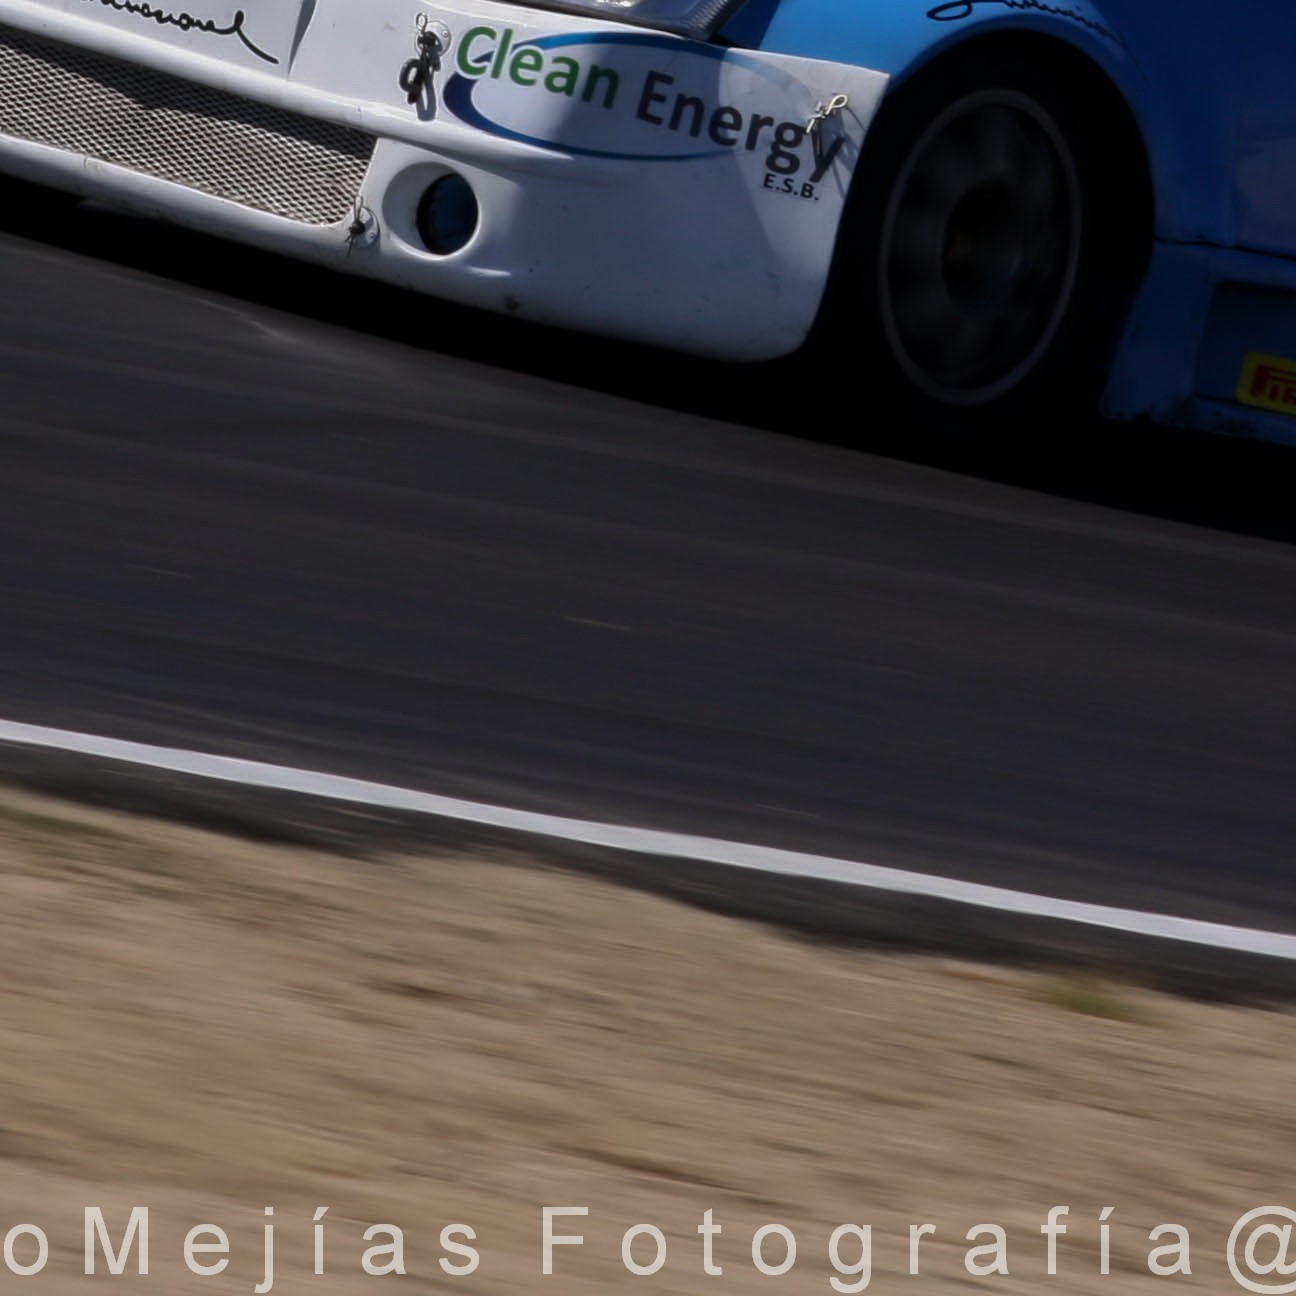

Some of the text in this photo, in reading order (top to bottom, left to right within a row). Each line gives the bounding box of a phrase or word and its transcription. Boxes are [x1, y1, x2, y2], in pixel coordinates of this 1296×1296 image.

[455, 26, 845, 183] Clean Energy
[763, 172, 820, 201] E.S.B.
